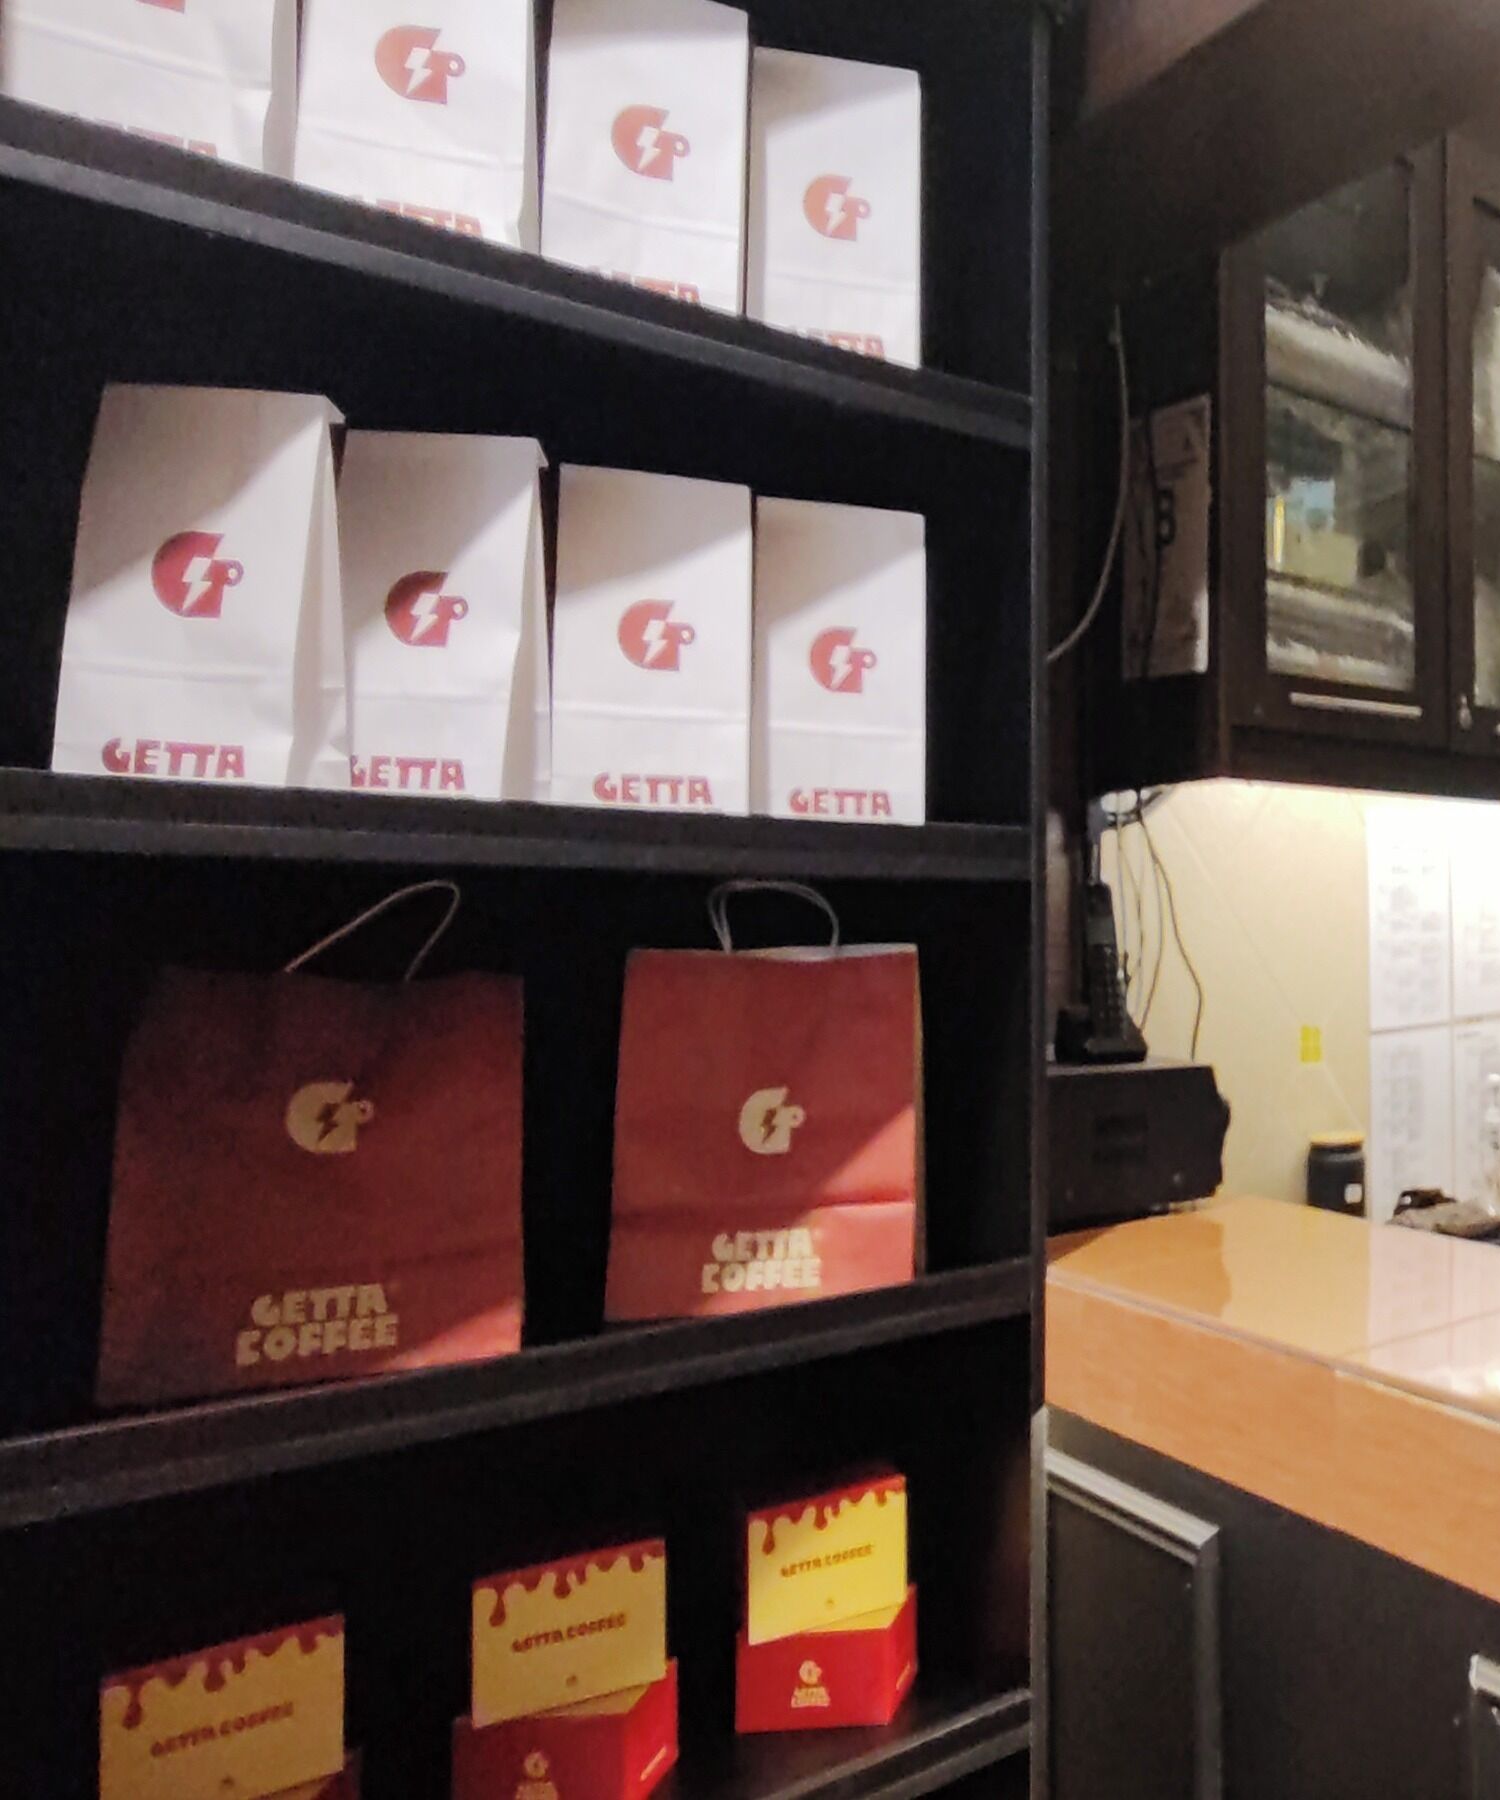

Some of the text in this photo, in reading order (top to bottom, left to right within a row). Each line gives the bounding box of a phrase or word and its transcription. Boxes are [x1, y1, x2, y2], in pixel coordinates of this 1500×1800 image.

[102, 738, 246, 779] GETTA
[593, 772, 714, 805] GETTA
[789, 787, 893, 817] GETTA
[712, 1227, 814, 1262] GETTA
[702, 1257, 821, 1293] COFFEE
[251, 1284, 388, 1327] GETTA
[236, 1314, 398, 1367] COFFEE
